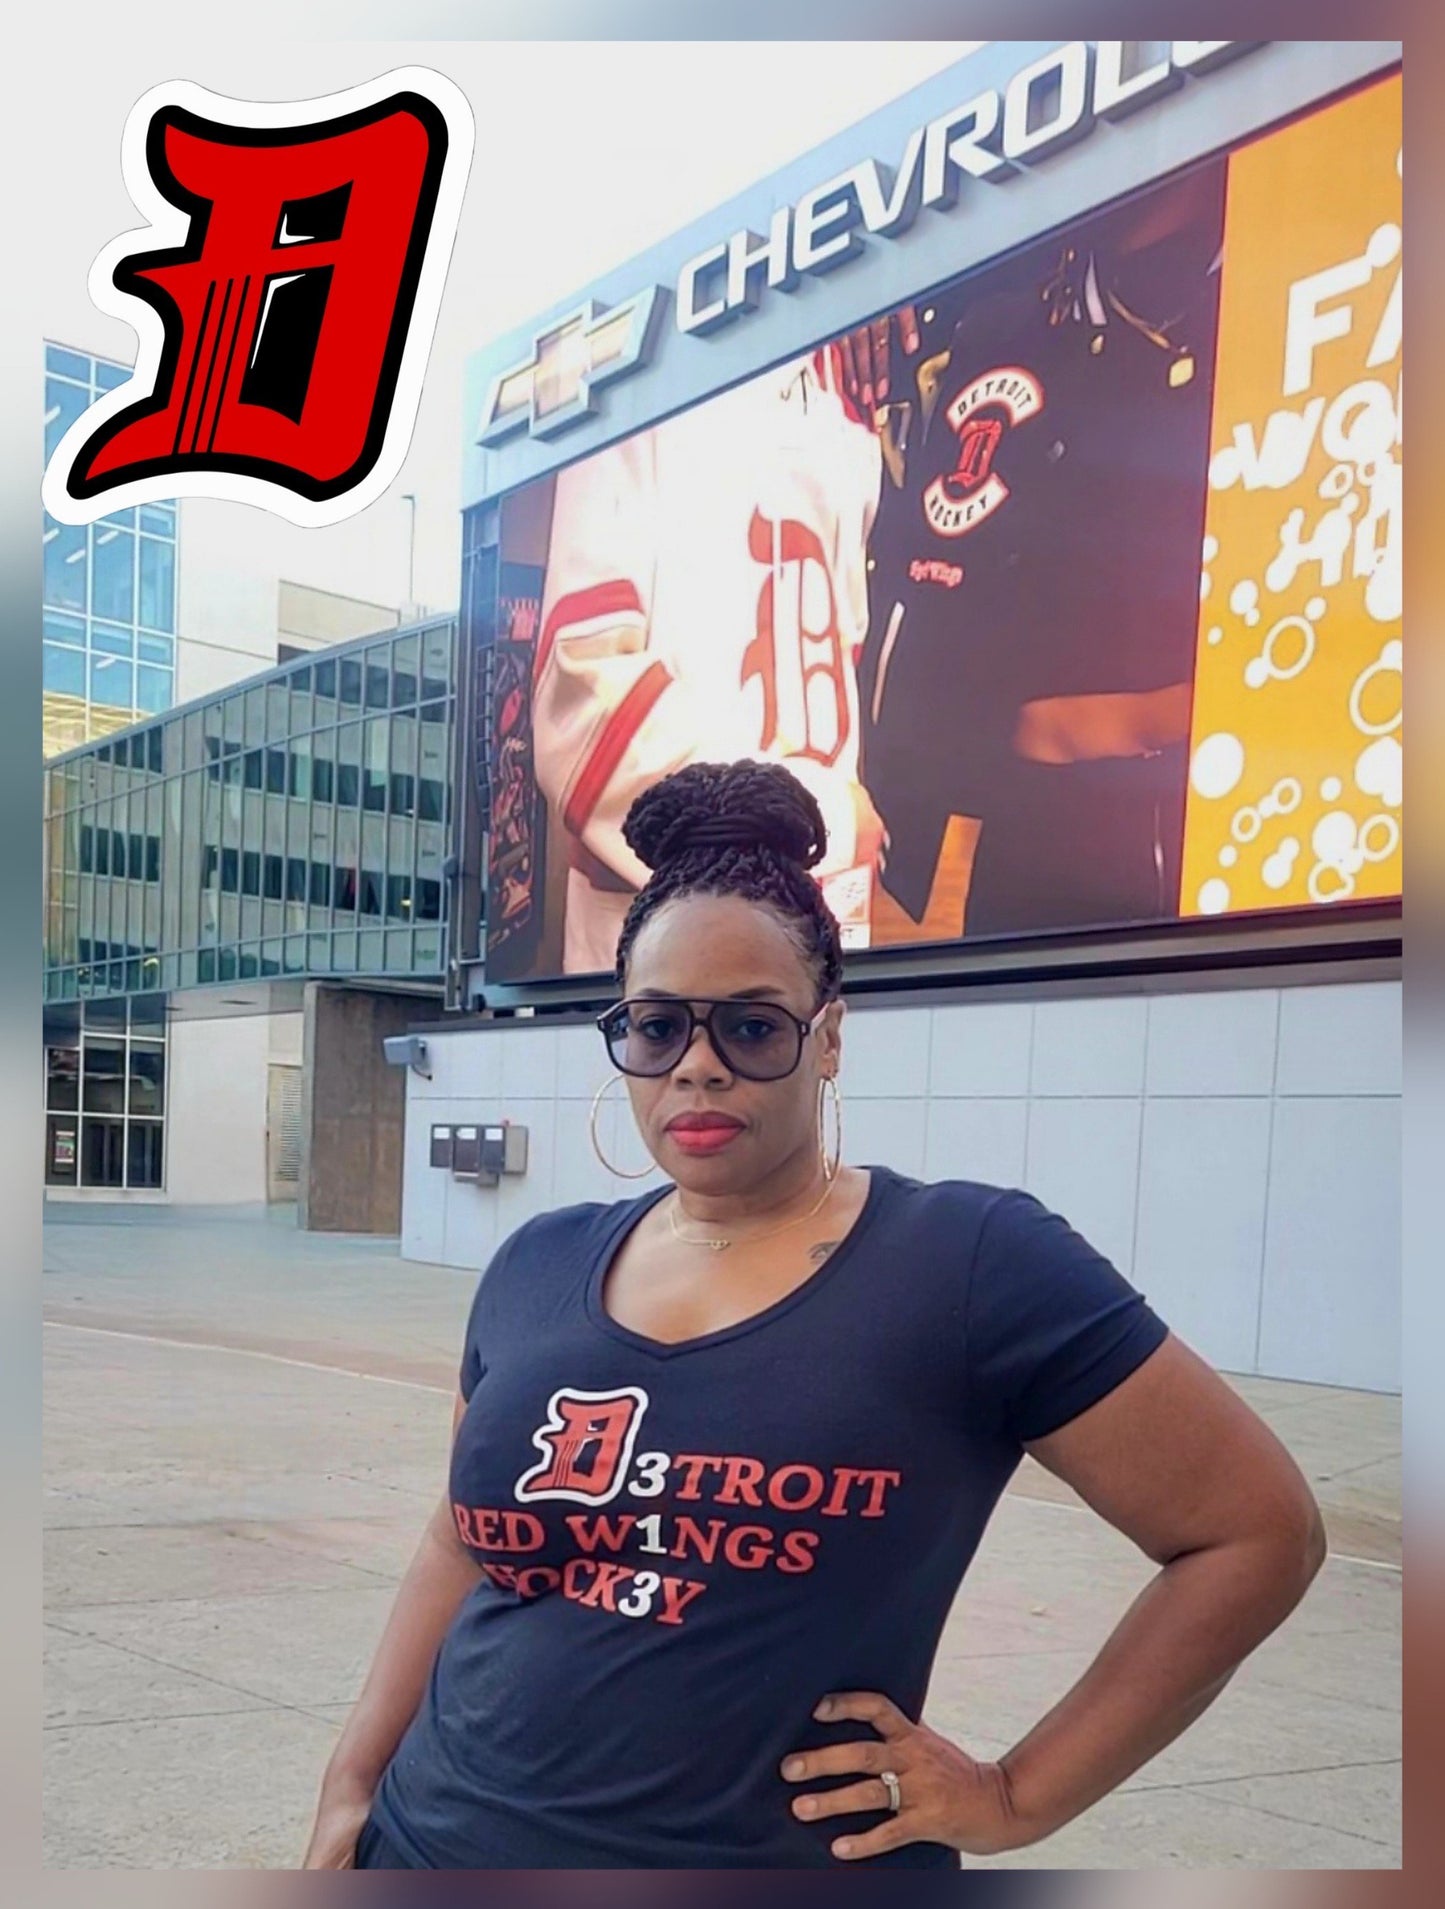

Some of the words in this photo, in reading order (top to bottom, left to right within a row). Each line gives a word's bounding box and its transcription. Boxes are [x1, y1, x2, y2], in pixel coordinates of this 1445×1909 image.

[676, 41, 1235, 334] CHEVROL
[928, 494, 988, 528] HOCKEY
[564, 1512, 821, 1575] W1NGS
